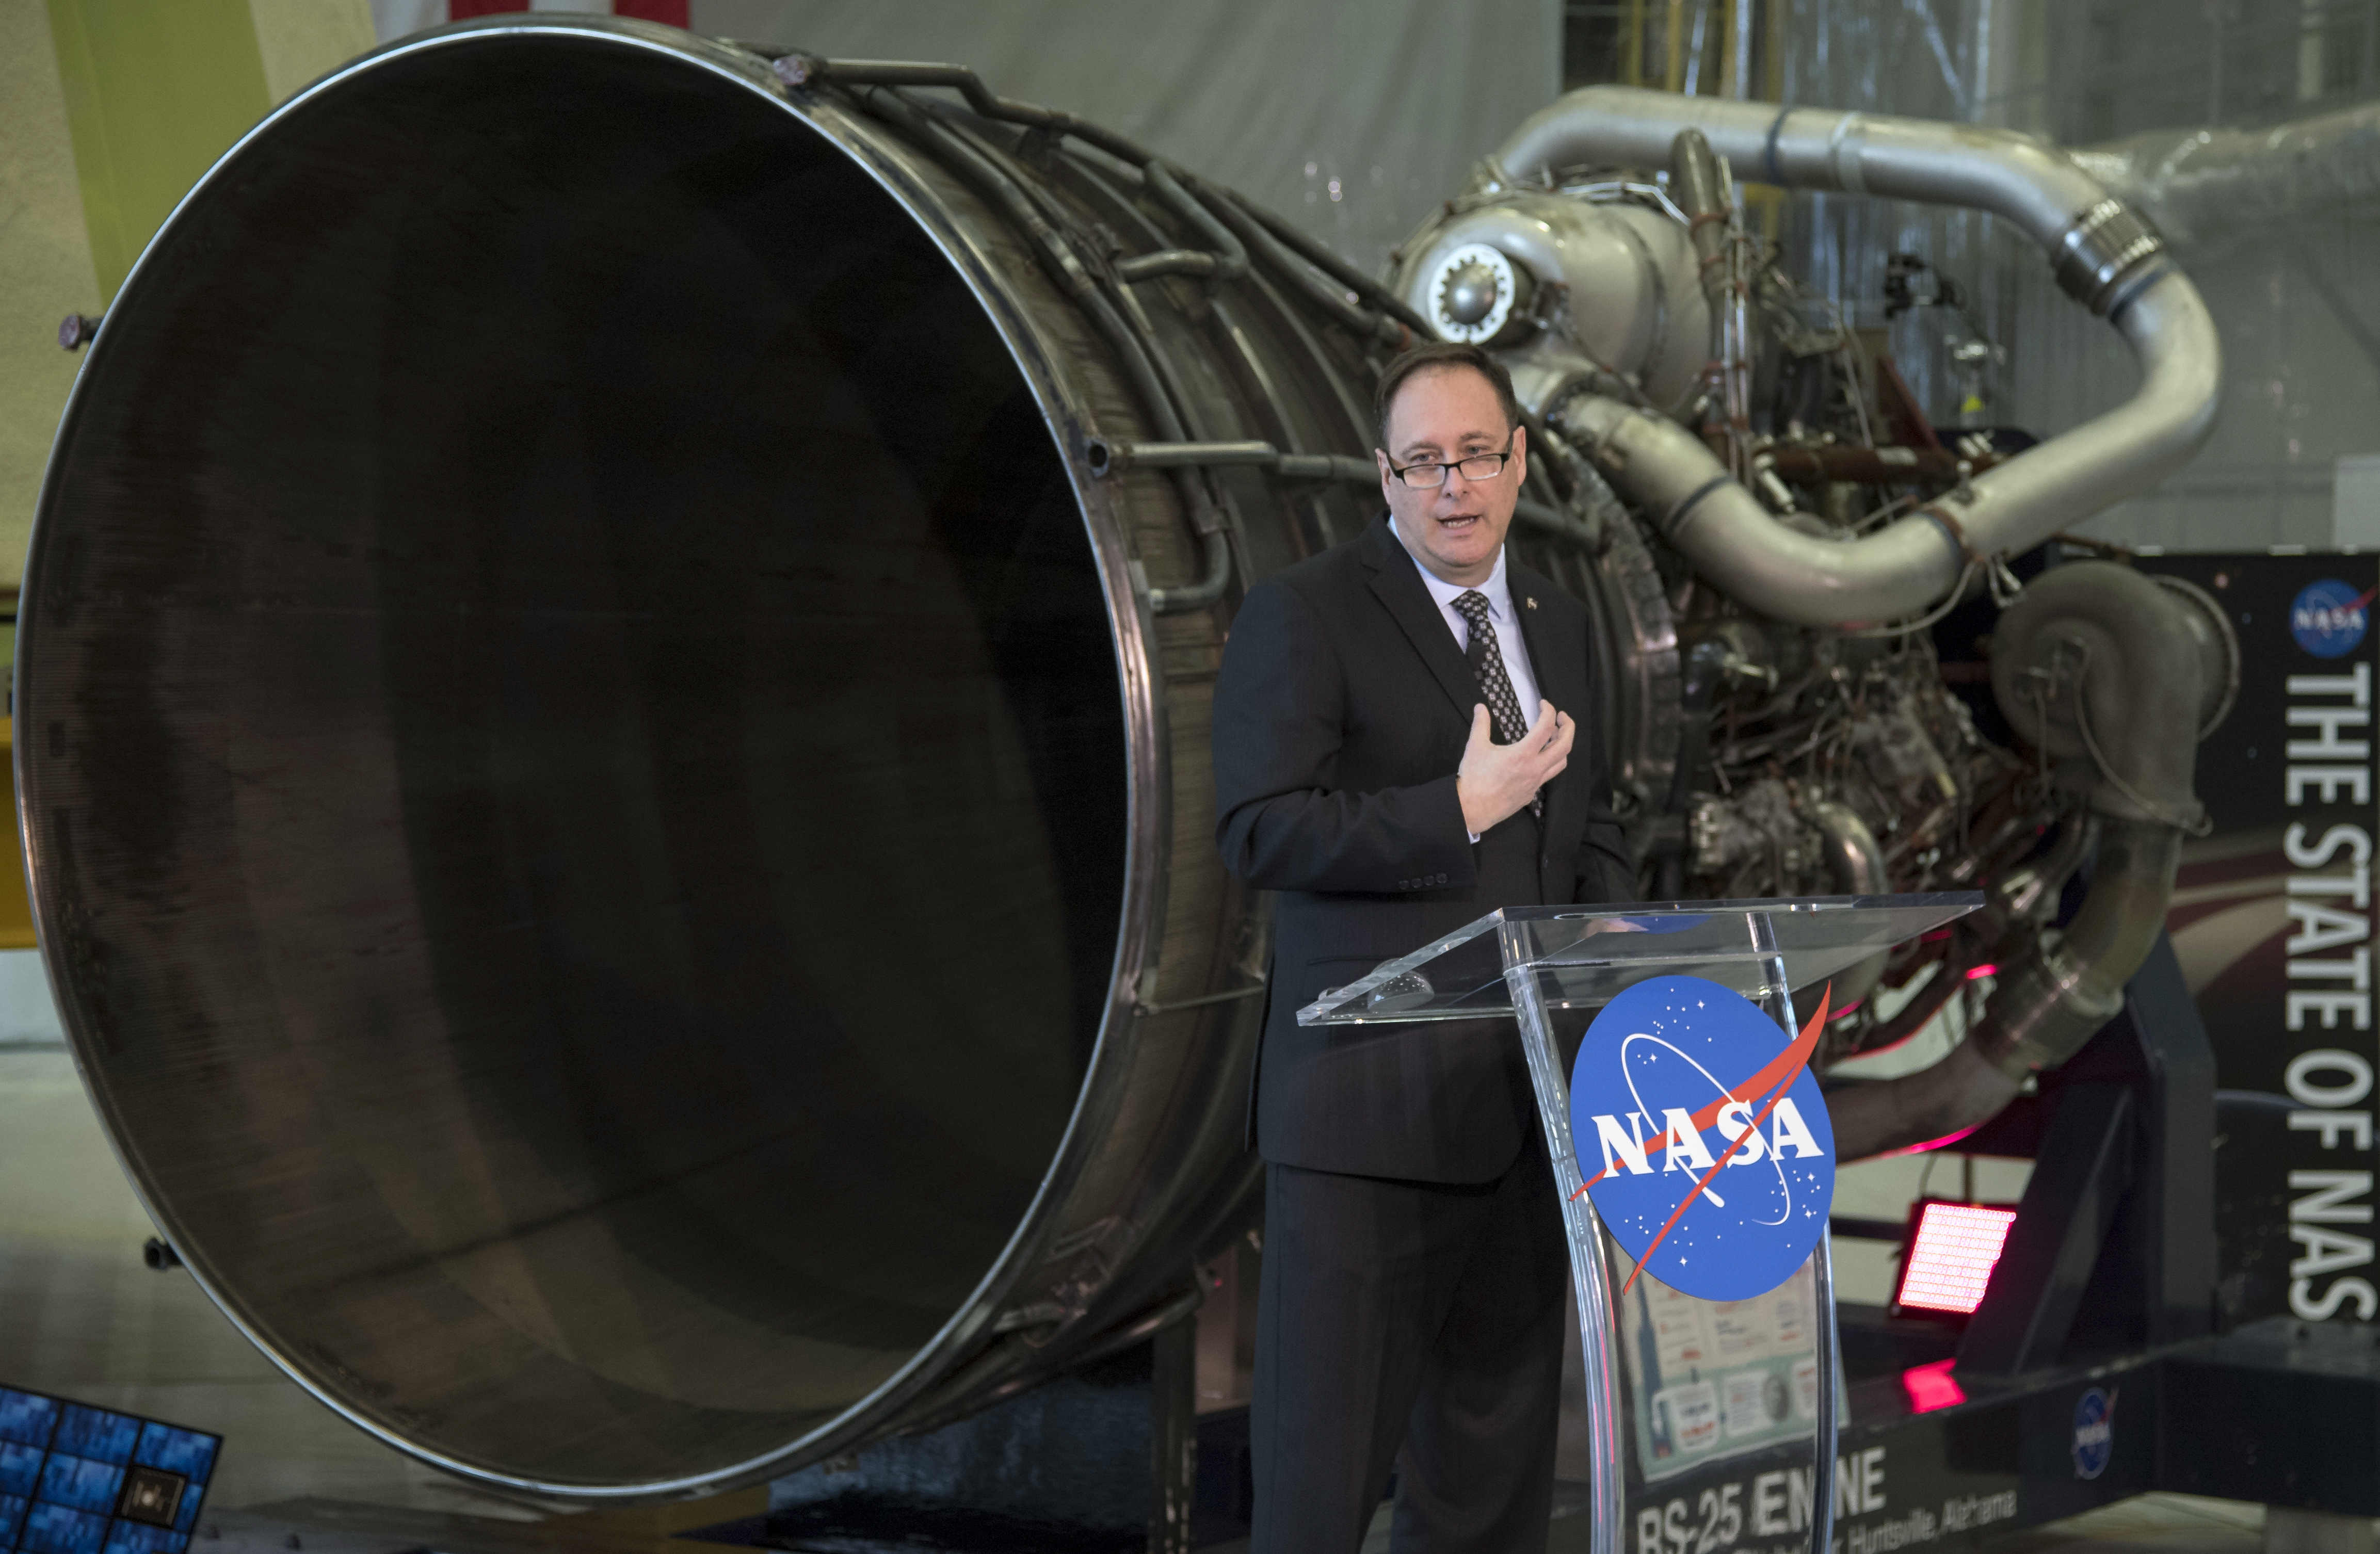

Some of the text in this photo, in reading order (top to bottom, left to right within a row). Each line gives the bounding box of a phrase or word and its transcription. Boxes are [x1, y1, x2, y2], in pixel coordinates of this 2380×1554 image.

[2294, 607, 2366, 630] NASA
[2285, 661, 2372, 806] THE
[2283, 821, 2373, 1031] STATE
[1591, 1097, 1825, 1178] NASA
[2284, 1048, 2373, 1152] OF
[1637, 1445, 1887, 1554] RS-25 ENNE
